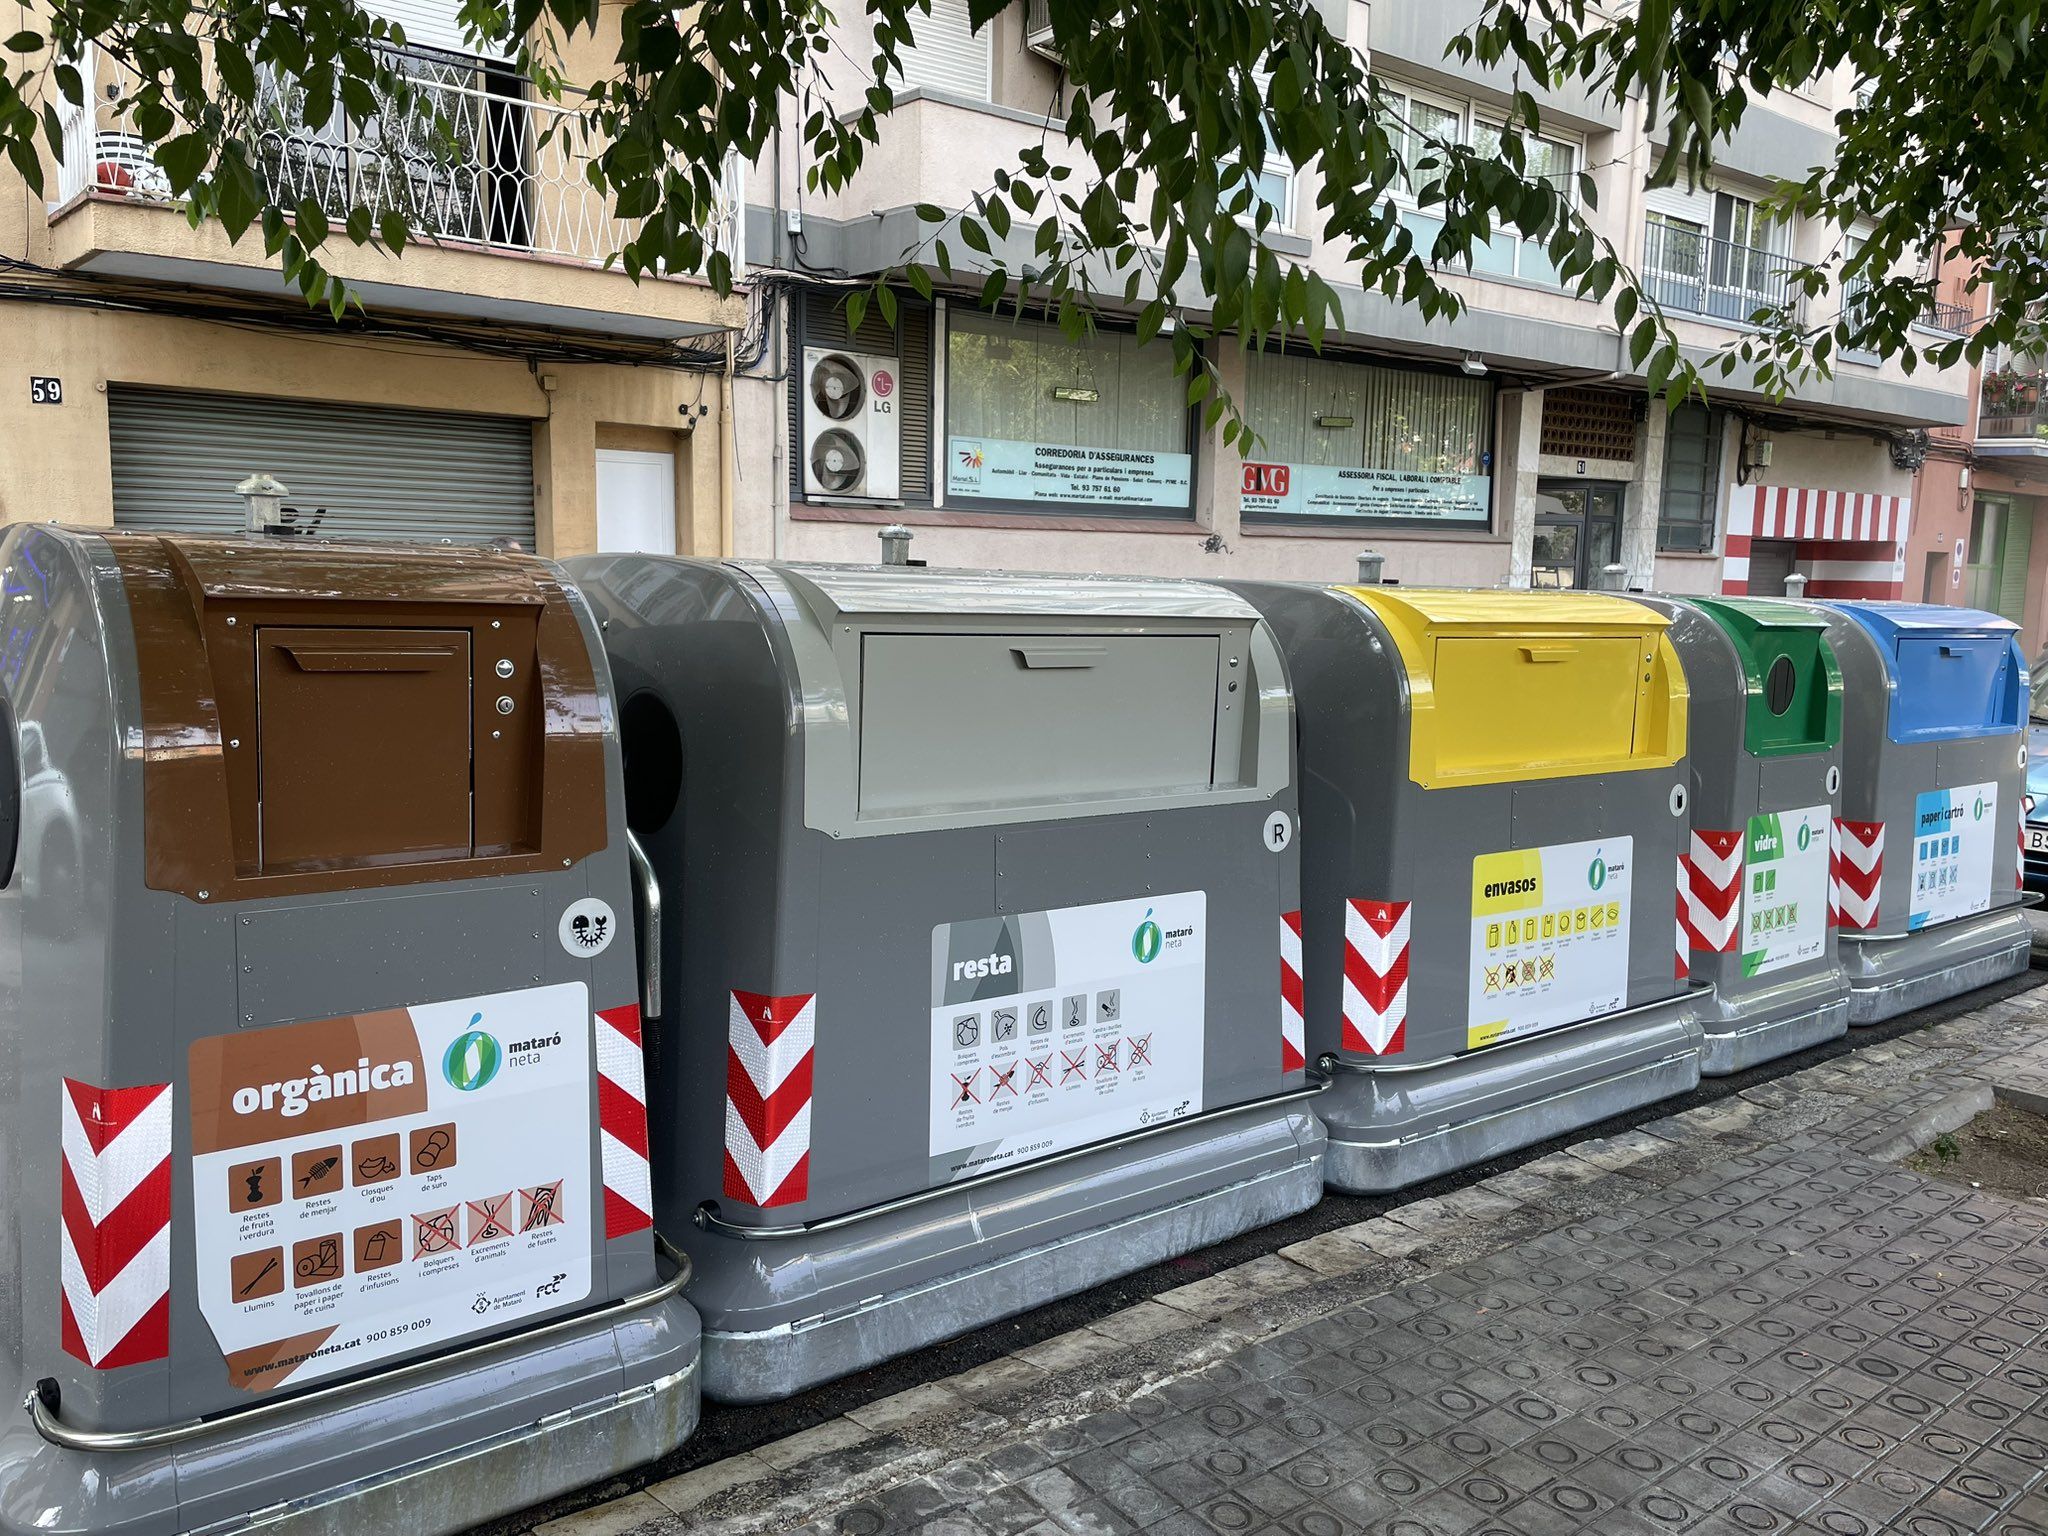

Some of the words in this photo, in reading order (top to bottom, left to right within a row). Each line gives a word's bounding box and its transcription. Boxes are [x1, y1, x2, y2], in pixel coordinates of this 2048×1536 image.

[32, 379, 61, 401] 59
[874, 400, 891, 414] LG
[1035, 447, 1086, 459] CORREDORIA
[1088, 451, 1155, 464] D'ASSEGURANCES
[1034, 462, 1075, 471] Assegurances
[1093, 466, 1123, 474] particulars
[1338, 471, 1375, 480] ASSESSORIA
[1376, 473, 1398, 481] FISCAL,
[1399, 474, 1425, 483] LABORAL
[1430, 476, 1462, 484] COMPTABLE
[1921, 811, 1940, 828] paper
[1941, 807, 1944, 820] i
[1944, 803, 1964, 820] cartró
[1274, 823, 1284, 844] R
[1754, 834, 1778, 852] vidre
[1484, 877, 1537, 898] envasos
[1165, 925, 1193, 938] mataró
[1165, 939, 1182, 949] neta
[953, 953, 1012, 982] resta
[508, 1032, 562, 1053] mataró
[509, 1052, 541, 1067] neta
[232, 1057, 414, 1117] orgànica
[950, 1150, 1014, 1172] www.mataroneta.cat
[1016, 1146, 1029, 1156] 900
[1030, 1143, 1041, 1152] 859
[1041, 1139, 1054, 1149] 009
[421, 1184, 431, 1192] de
[431, 1180, 448, 1190] suro
[426, 1174, 443, 1183] Taps
[361, 1184, 394, 1197] Closques
[305, 1198, 332, 1209] Restes
[369, 1194, 386, 1204] d'ou
[243, 1212, 270, 1223] Restes
[299, 1211, 310, 1220] de
[311, 1205, 338, 1218] menjar
[240, 1224, 250, 1233] de
[251, 1218, 274, 1230] fruita
[243, 1228, 275, 1241] verdura
[531, 1230, 554, 1240] Restes
[470, 1241, 511, 1256] Excrements
[527, 1241, 537, 1249] de
[538, 1237, 558, 1247] fustes
[423, 1256, 455, 1269] Bolquers
[474, 1250, 507, 1263] d'animals
[367, 1270, 393, 1282] Restes
[422, 1262, 460, 1277] compreses
[296, 1286, 331, 1300] Tovallons
[332, 1283, 342, 1291] de
[359, 1277, 400, 1293] d'infusions
[536, 1280, 561, 1298] FCC
[294, 1299, 316, 1311] paper
[321, 1291, 345, 1304] paper
[493, 1289, 527, 1304] Ajuntament
[502, 1297, 523, 1308] Mataró
[243, 1300, 276, 1313] Llumins
[303, 1308, 314, 1316] de
[314, 1302, 336, 1313] cuina
[243, 1337, 362, 1377] www.mataroneta.cat
[366, 1330, 387, 1344] 900
[390, 1324, 409, 1338] 859
[411, 1317, 431, 1331] 009
